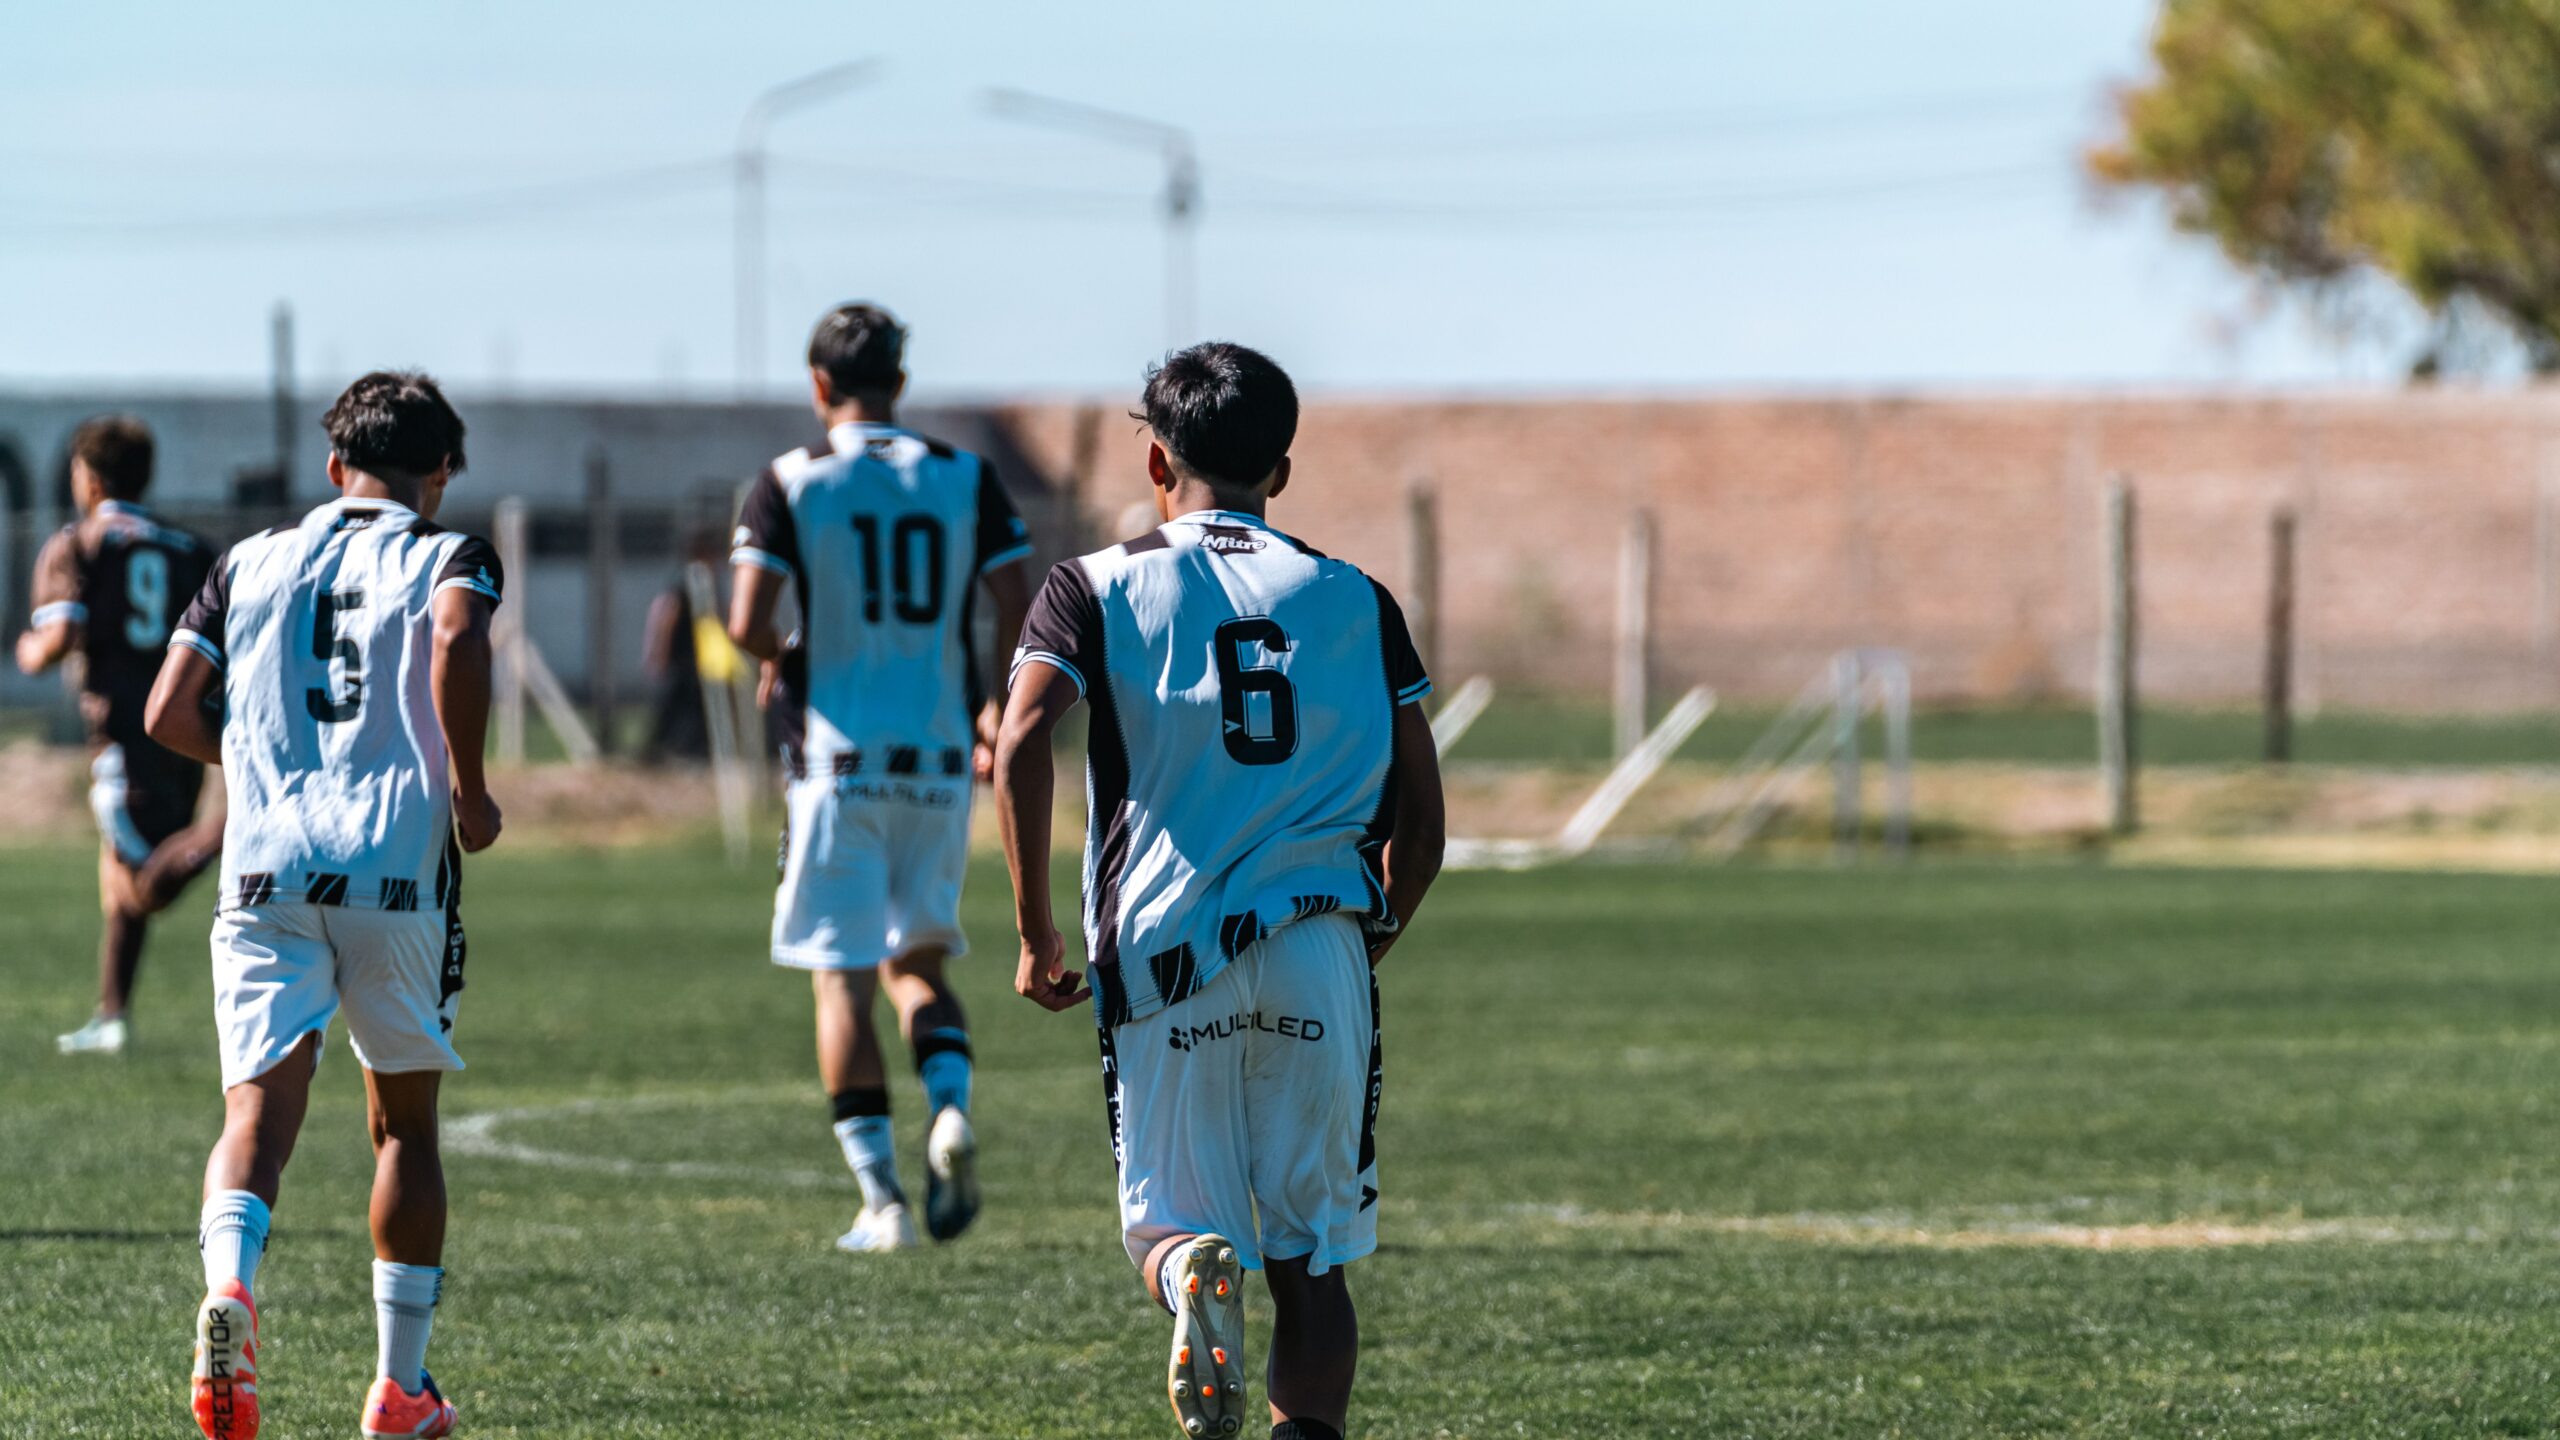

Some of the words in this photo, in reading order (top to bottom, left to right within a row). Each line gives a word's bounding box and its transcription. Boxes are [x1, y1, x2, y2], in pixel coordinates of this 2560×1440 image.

[851, 511, 945, 623] 10
[1199, 533, 1267, 551] Mitre
[127, 549, 167, 649] 9
[306, 586, 366, 723] 5
[1215, 614, 1300, 765] 6
[1190, 1011, 1325, 1046] MULILED
